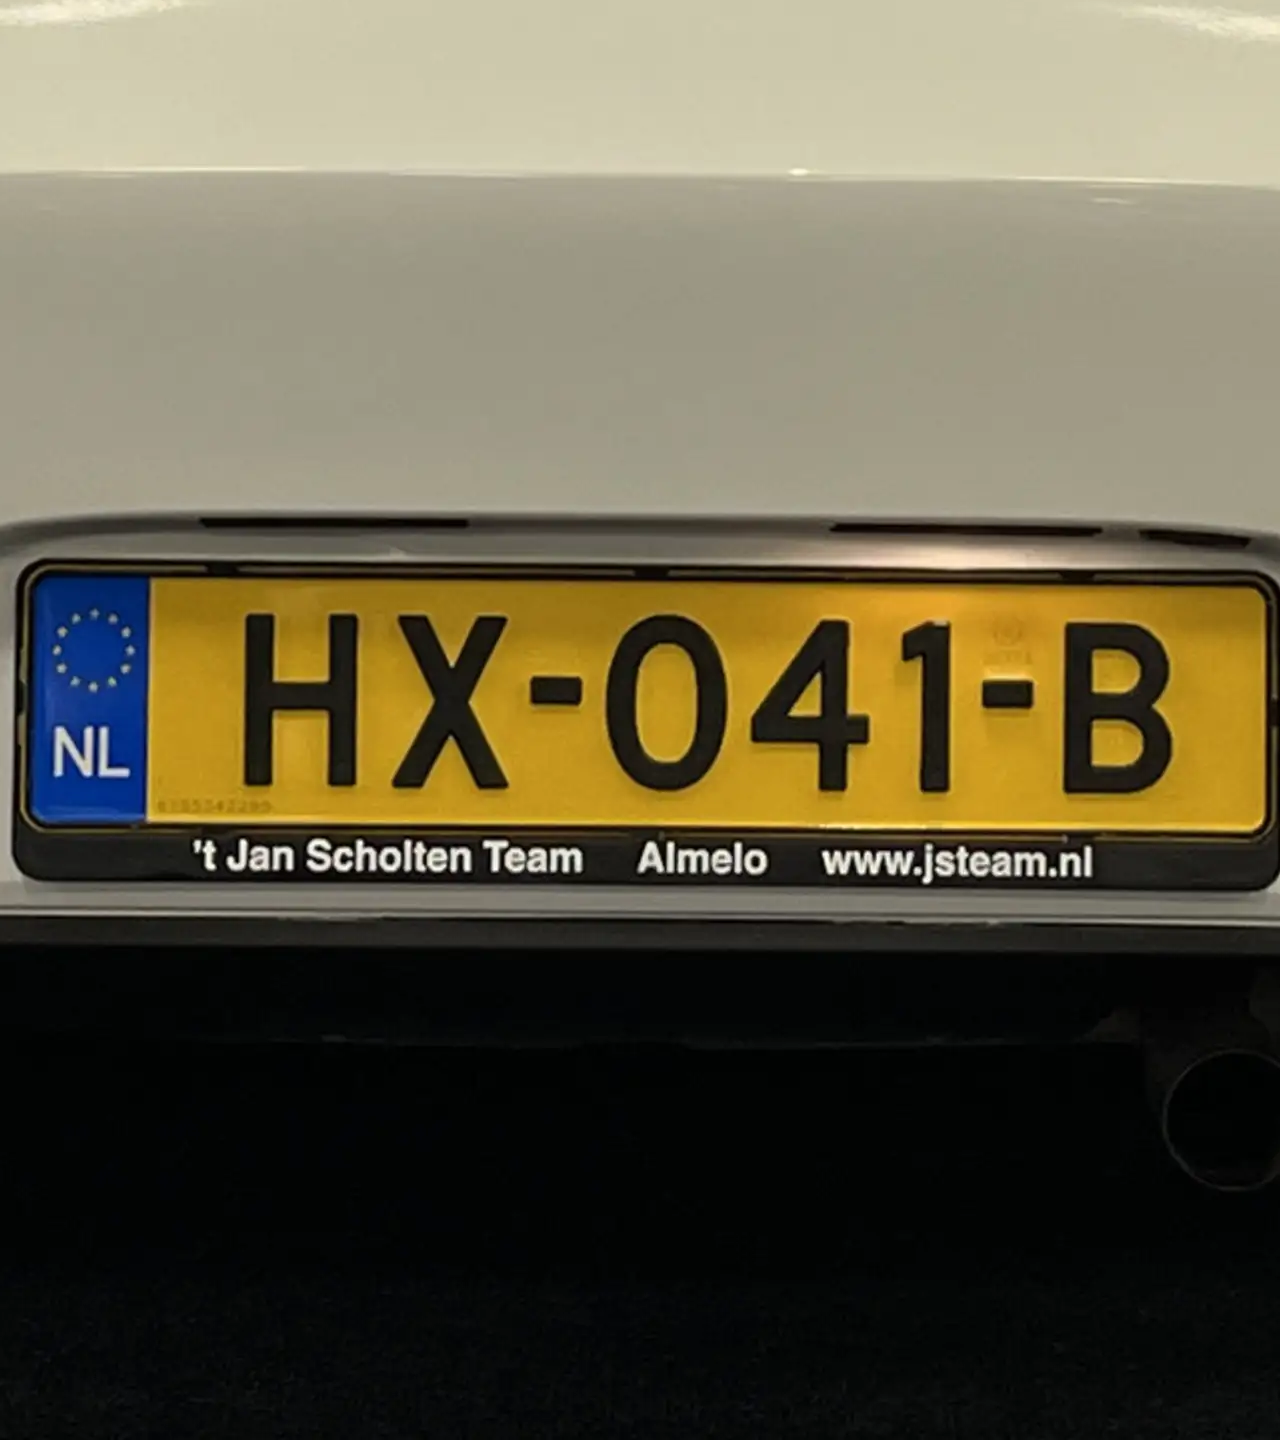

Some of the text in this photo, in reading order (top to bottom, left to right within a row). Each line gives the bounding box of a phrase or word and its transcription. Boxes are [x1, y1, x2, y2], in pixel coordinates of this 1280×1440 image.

[242, 612, 1173, 796] HX-041-B
[53, 726, 131, 778] NL
[193, 838, 1092, 885] 't Jan Scholten Team Almelo www.jsteam.nl
